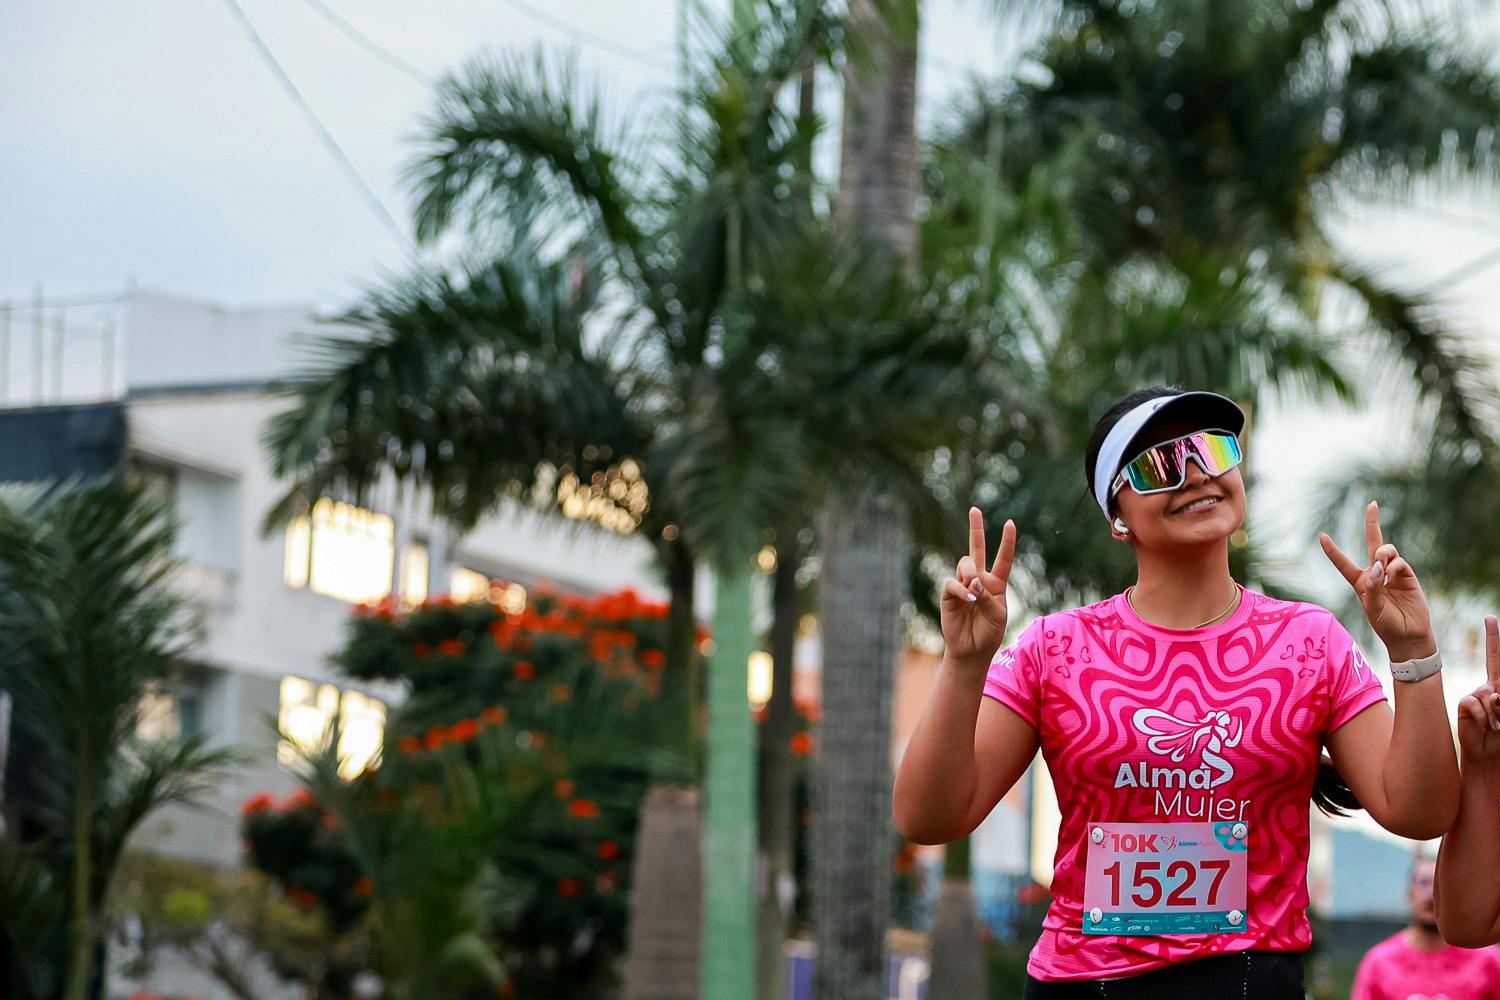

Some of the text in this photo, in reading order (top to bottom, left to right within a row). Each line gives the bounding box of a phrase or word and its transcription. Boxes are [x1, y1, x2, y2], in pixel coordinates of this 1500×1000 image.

[1114, 762, 1211, 790] Alma
[1154, 789, 1251, 823] Mujer
[1111, 833, 1160, 853] 10K
[1104, 860, 1231, 908] 1527
